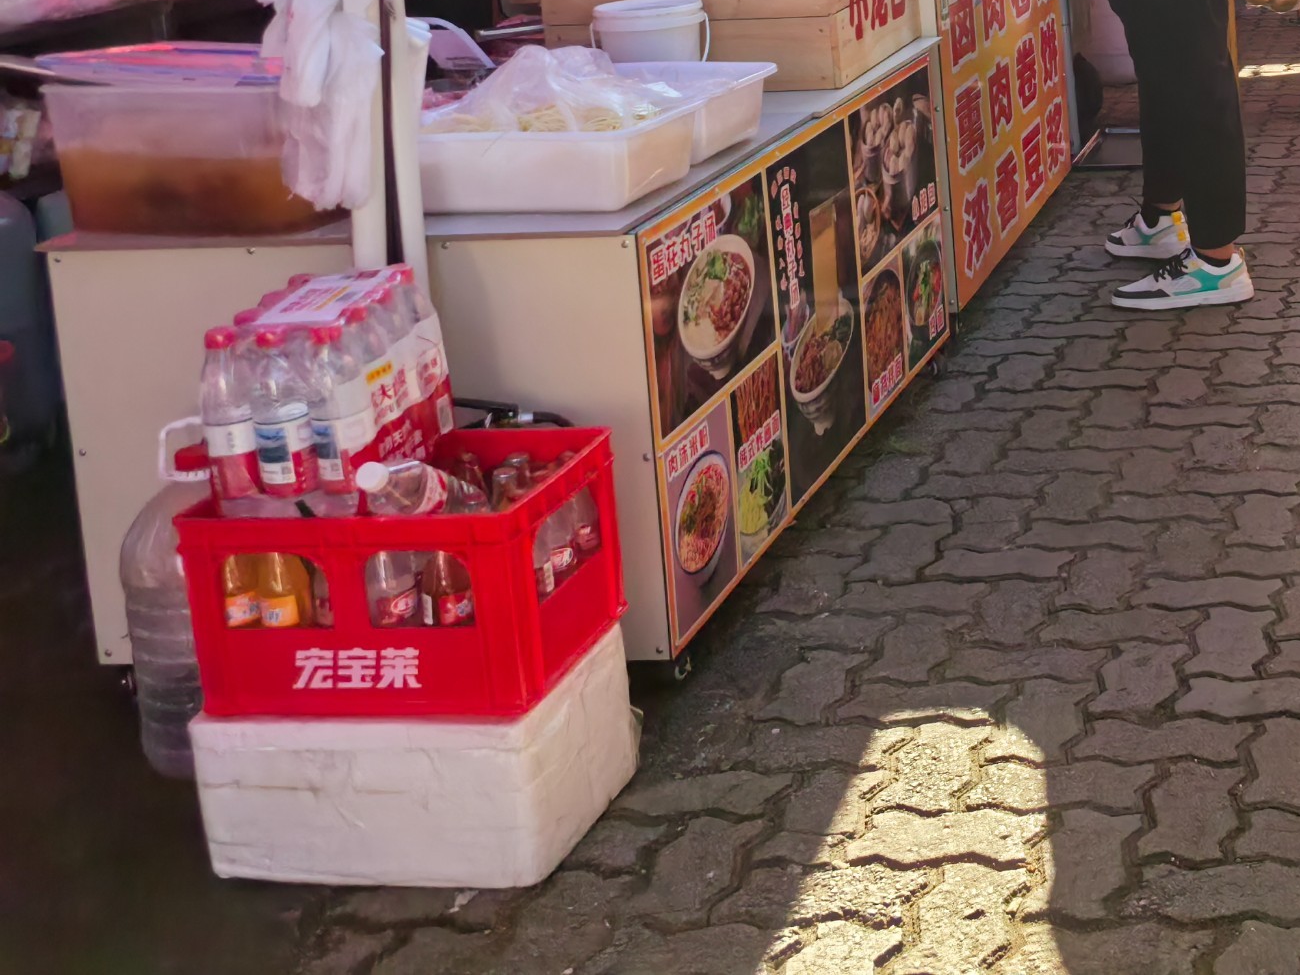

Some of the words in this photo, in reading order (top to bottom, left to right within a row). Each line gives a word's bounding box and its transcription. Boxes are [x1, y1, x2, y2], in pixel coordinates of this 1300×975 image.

[962, 95, 1066, 279] 浓香豆浆
[650, 211, 717, 284] 蛋花丸子汤
[292, 646, 422, 689] 宏宝莱
